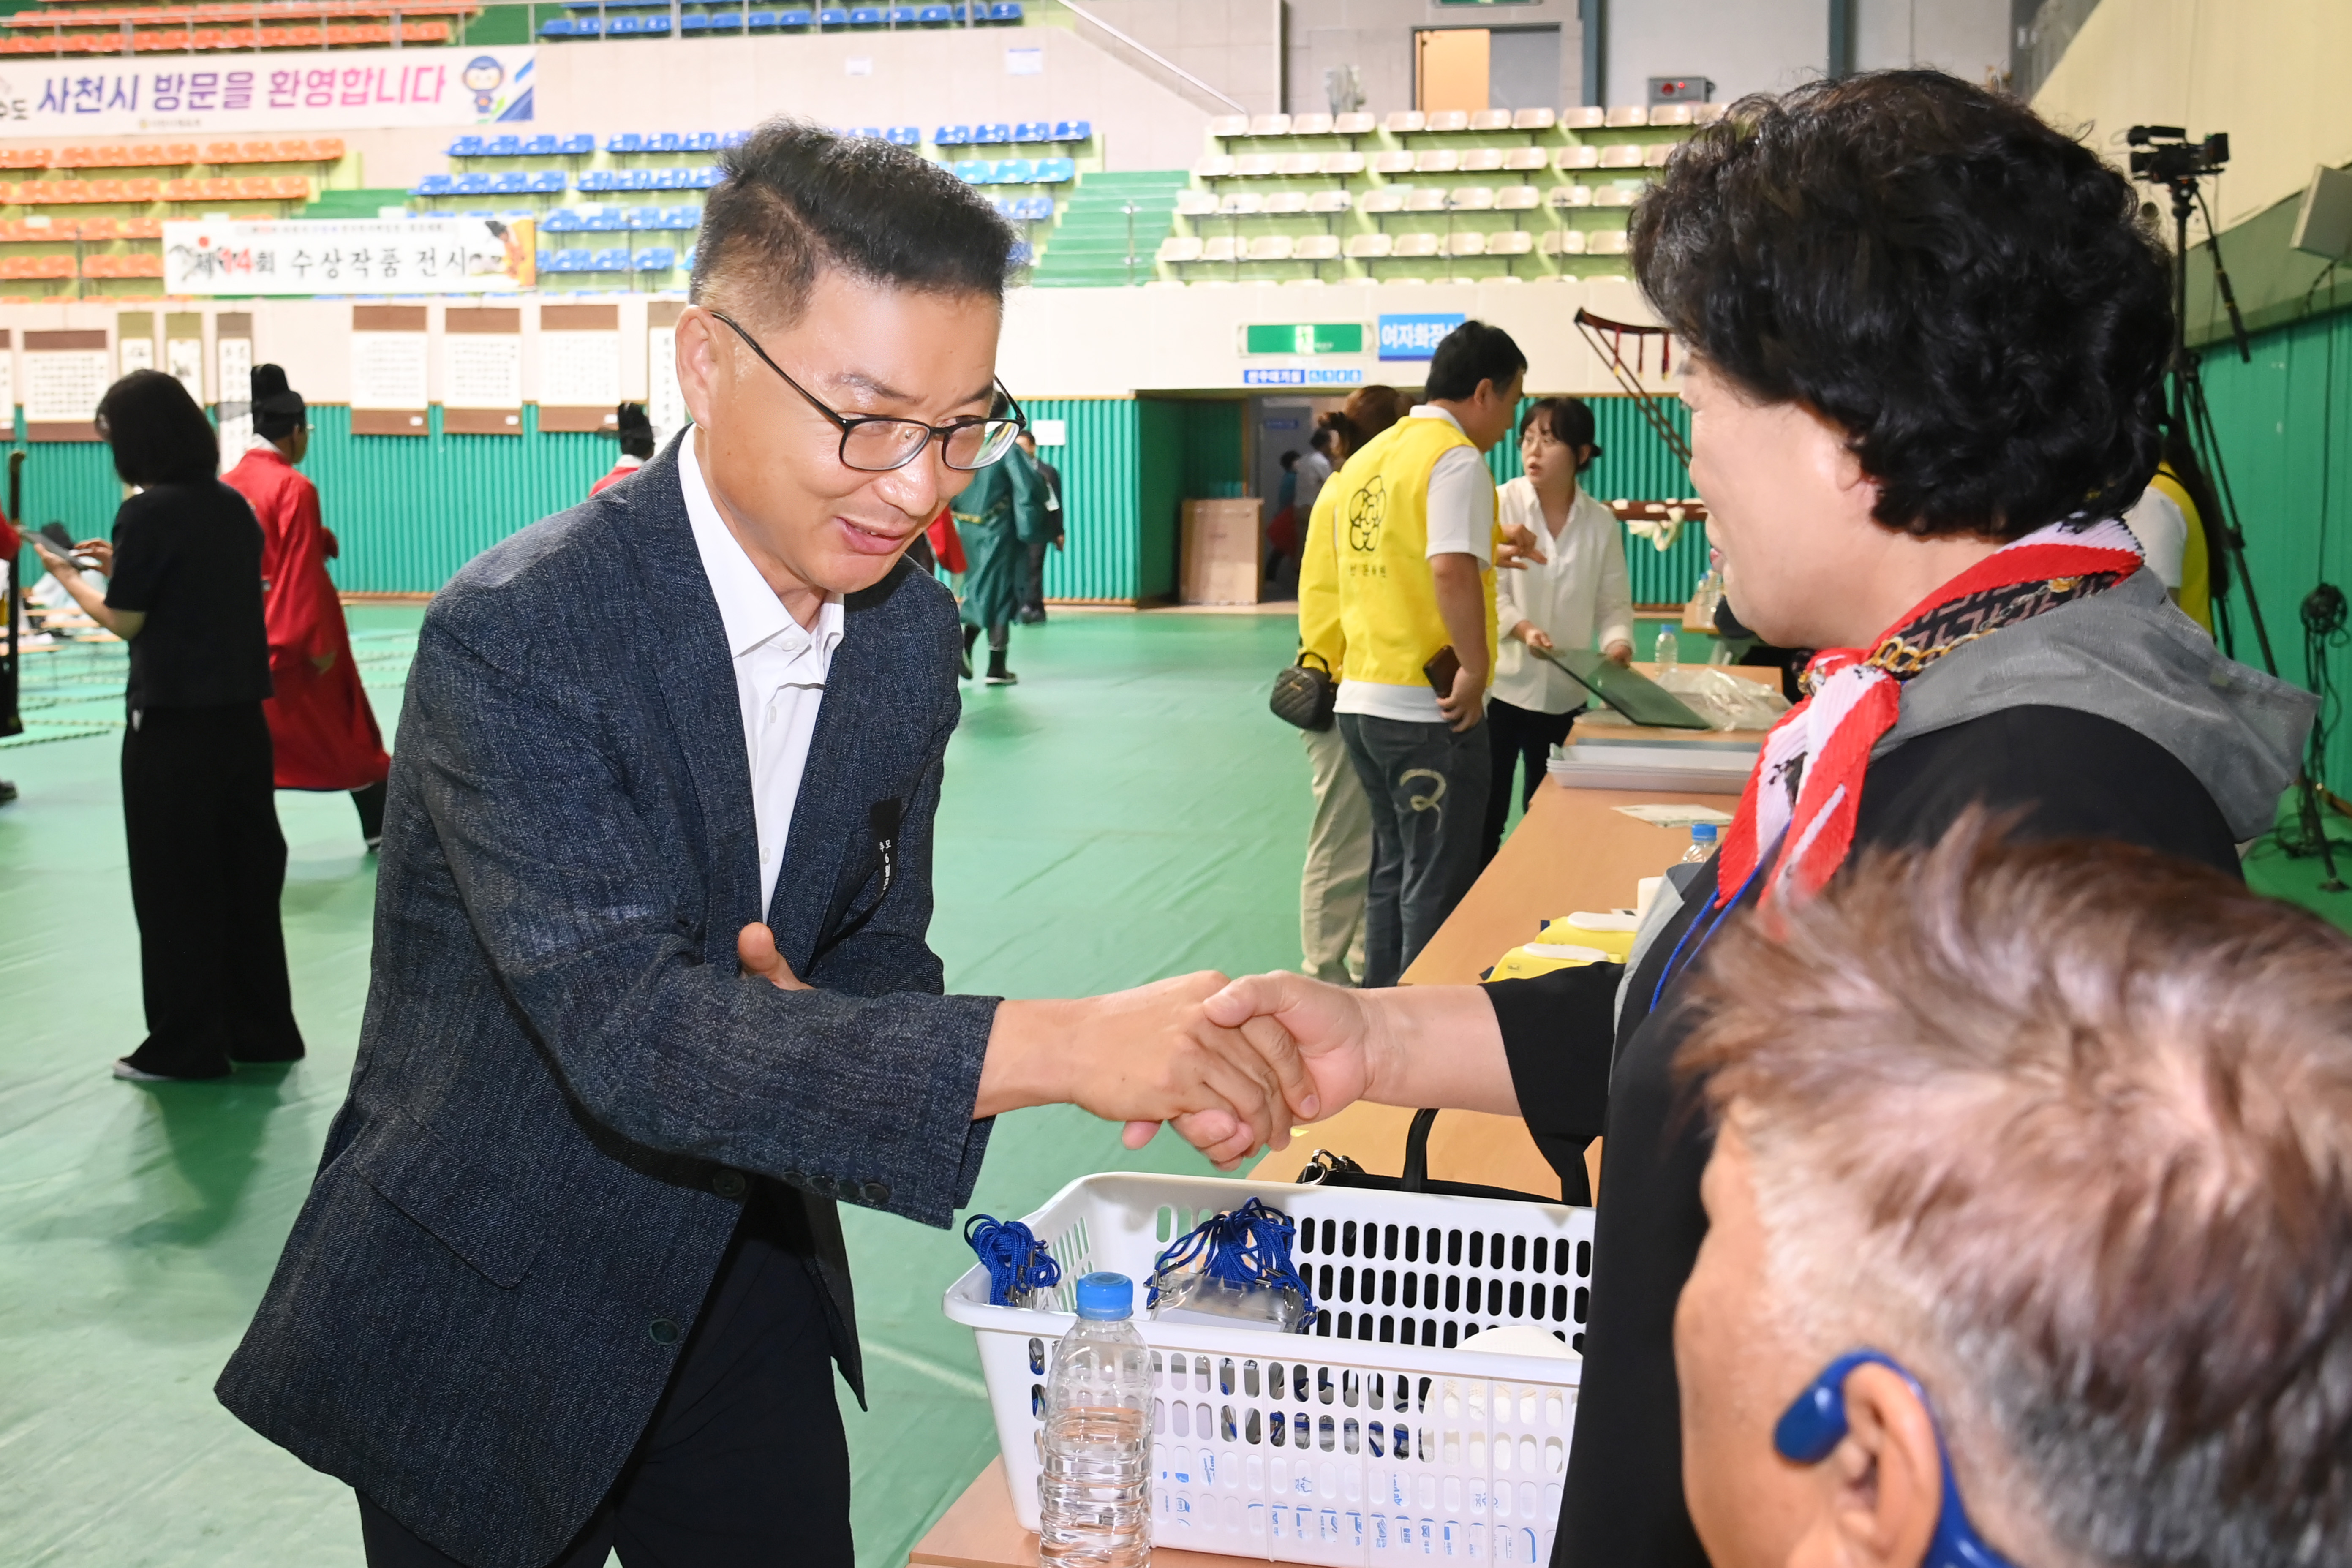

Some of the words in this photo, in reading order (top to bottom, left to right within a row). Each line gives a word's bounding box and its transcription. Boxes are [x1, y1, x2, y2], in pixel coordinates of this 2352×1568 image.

[38, 74, 139, 113] 사천시
[154, 71, 254, 111] 방문을
[269, 65, 446, 107] 환영합니다
[291, 248, 400, 278] 수상작품
[417, 248, 467, 277] 전시
[1381, 323, 1460, 349] 여자화장
